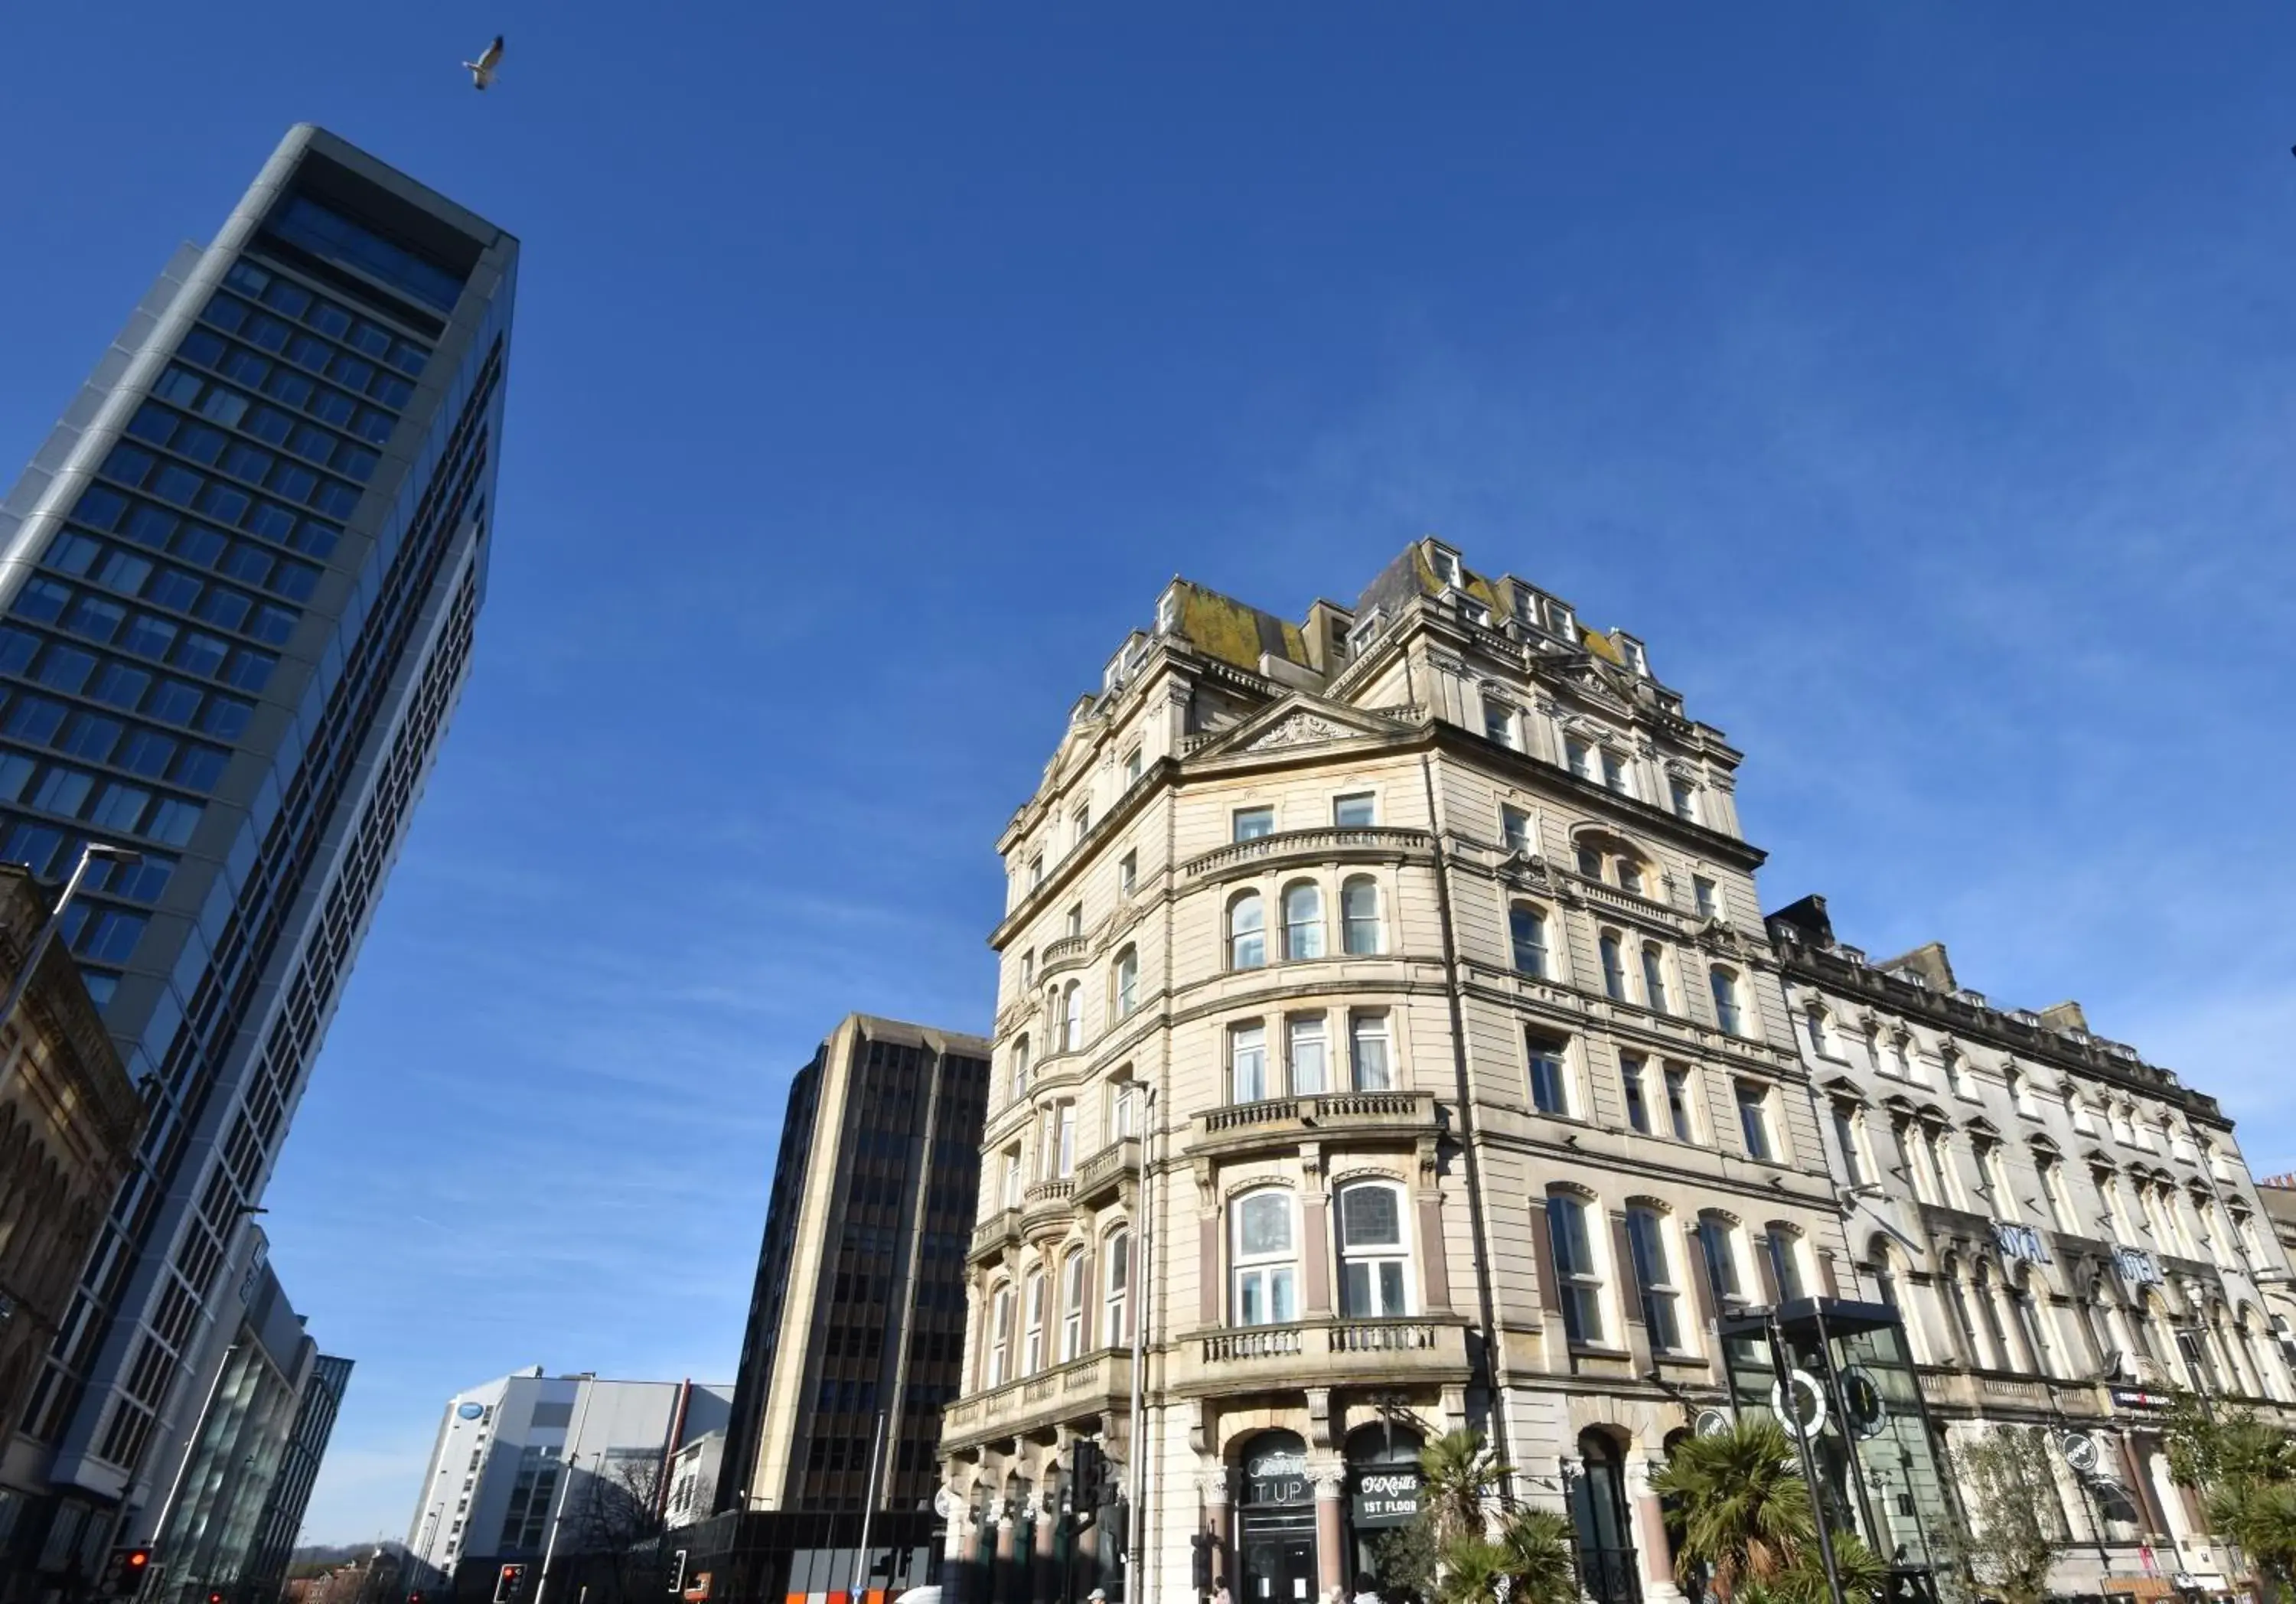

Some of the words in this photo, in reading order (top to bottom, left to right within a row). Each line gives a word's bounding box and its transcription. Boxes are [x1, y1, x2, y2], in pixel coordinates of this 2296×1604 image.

[1274, 1480, 1302, 1502] UP
[1362, 1475, 1417, 1498] O'Neill's
[1364, 1501, 1381, 1513] 1ST
[1384, 1500, 1417, 1513] FLOOR
